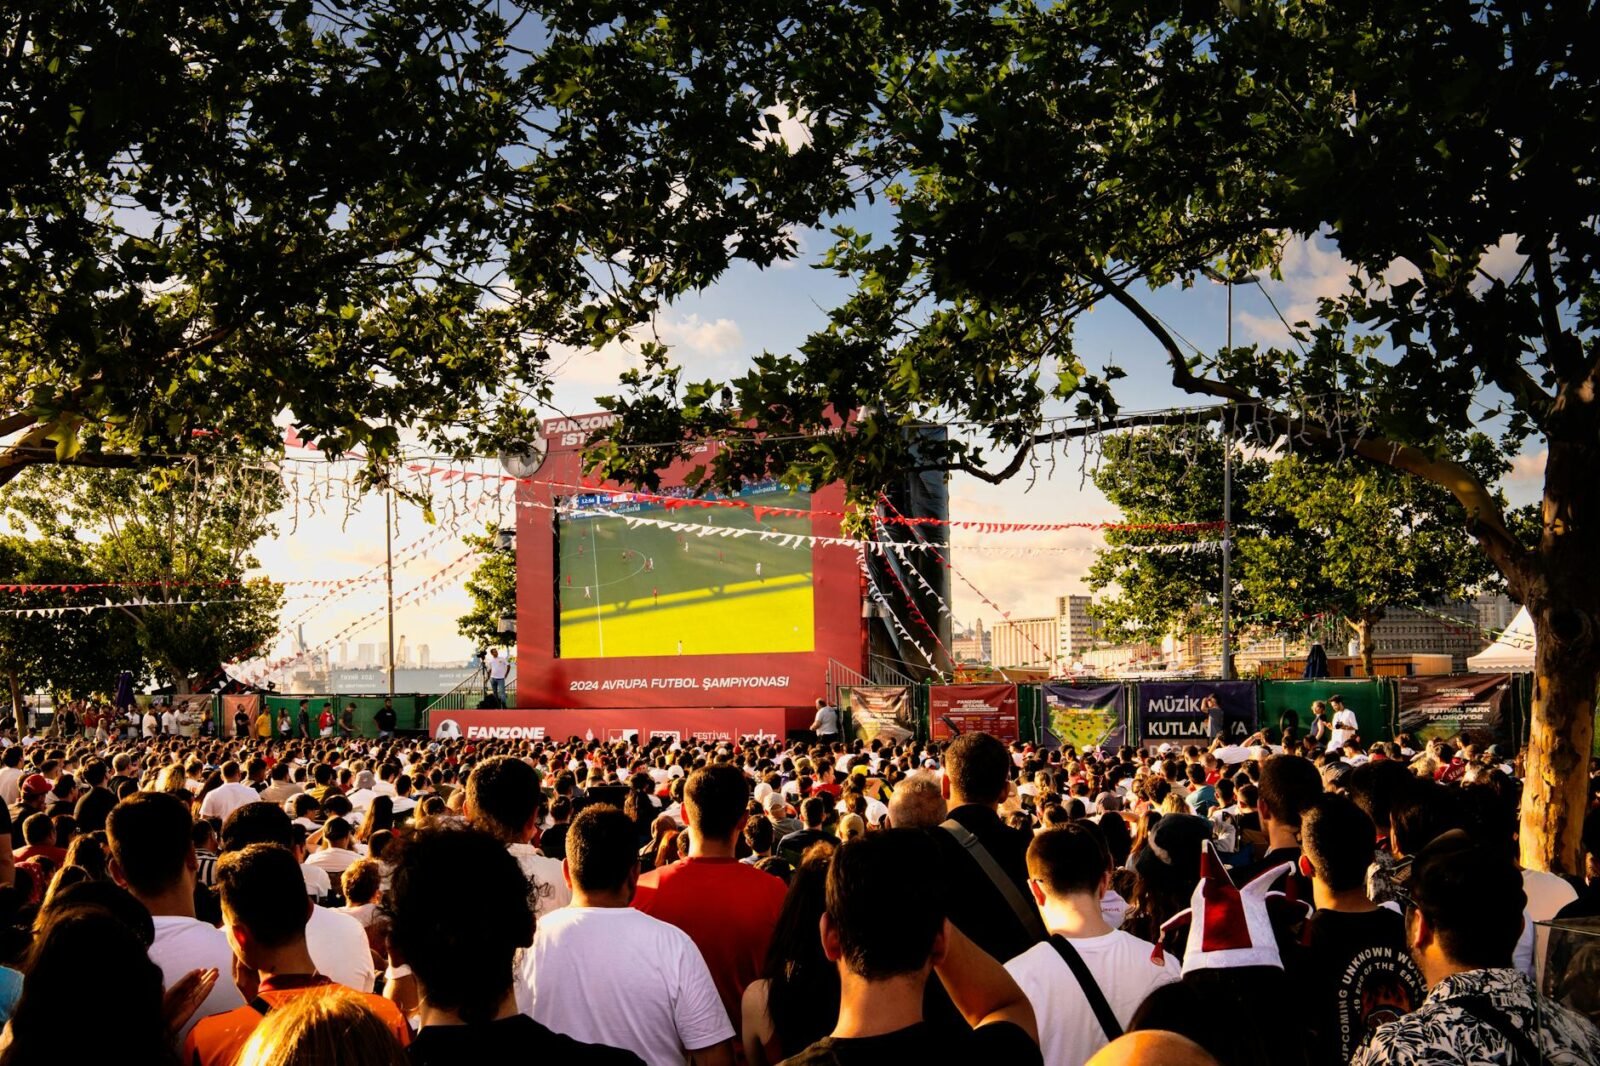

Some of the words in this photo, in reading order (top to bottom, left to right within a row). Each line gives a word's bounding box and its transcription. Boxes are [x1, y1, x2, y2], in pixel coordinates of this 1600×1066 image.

[570, 680, 599, 690] 2024
[601, 679, 648, 690] AVRUPA
[651, 677, 699, 689] FUTBOL
[1148, 695, 1201, 713] MÜZİK
[467, 726, 545, 739] FANZONE
[1341, 947, 1392, 985] UNKNOWN
[1364, 964, 1373, 976] OF
[1375, 962, 1395, 972] THE
[1399, 969, 1416, 988] ERA
